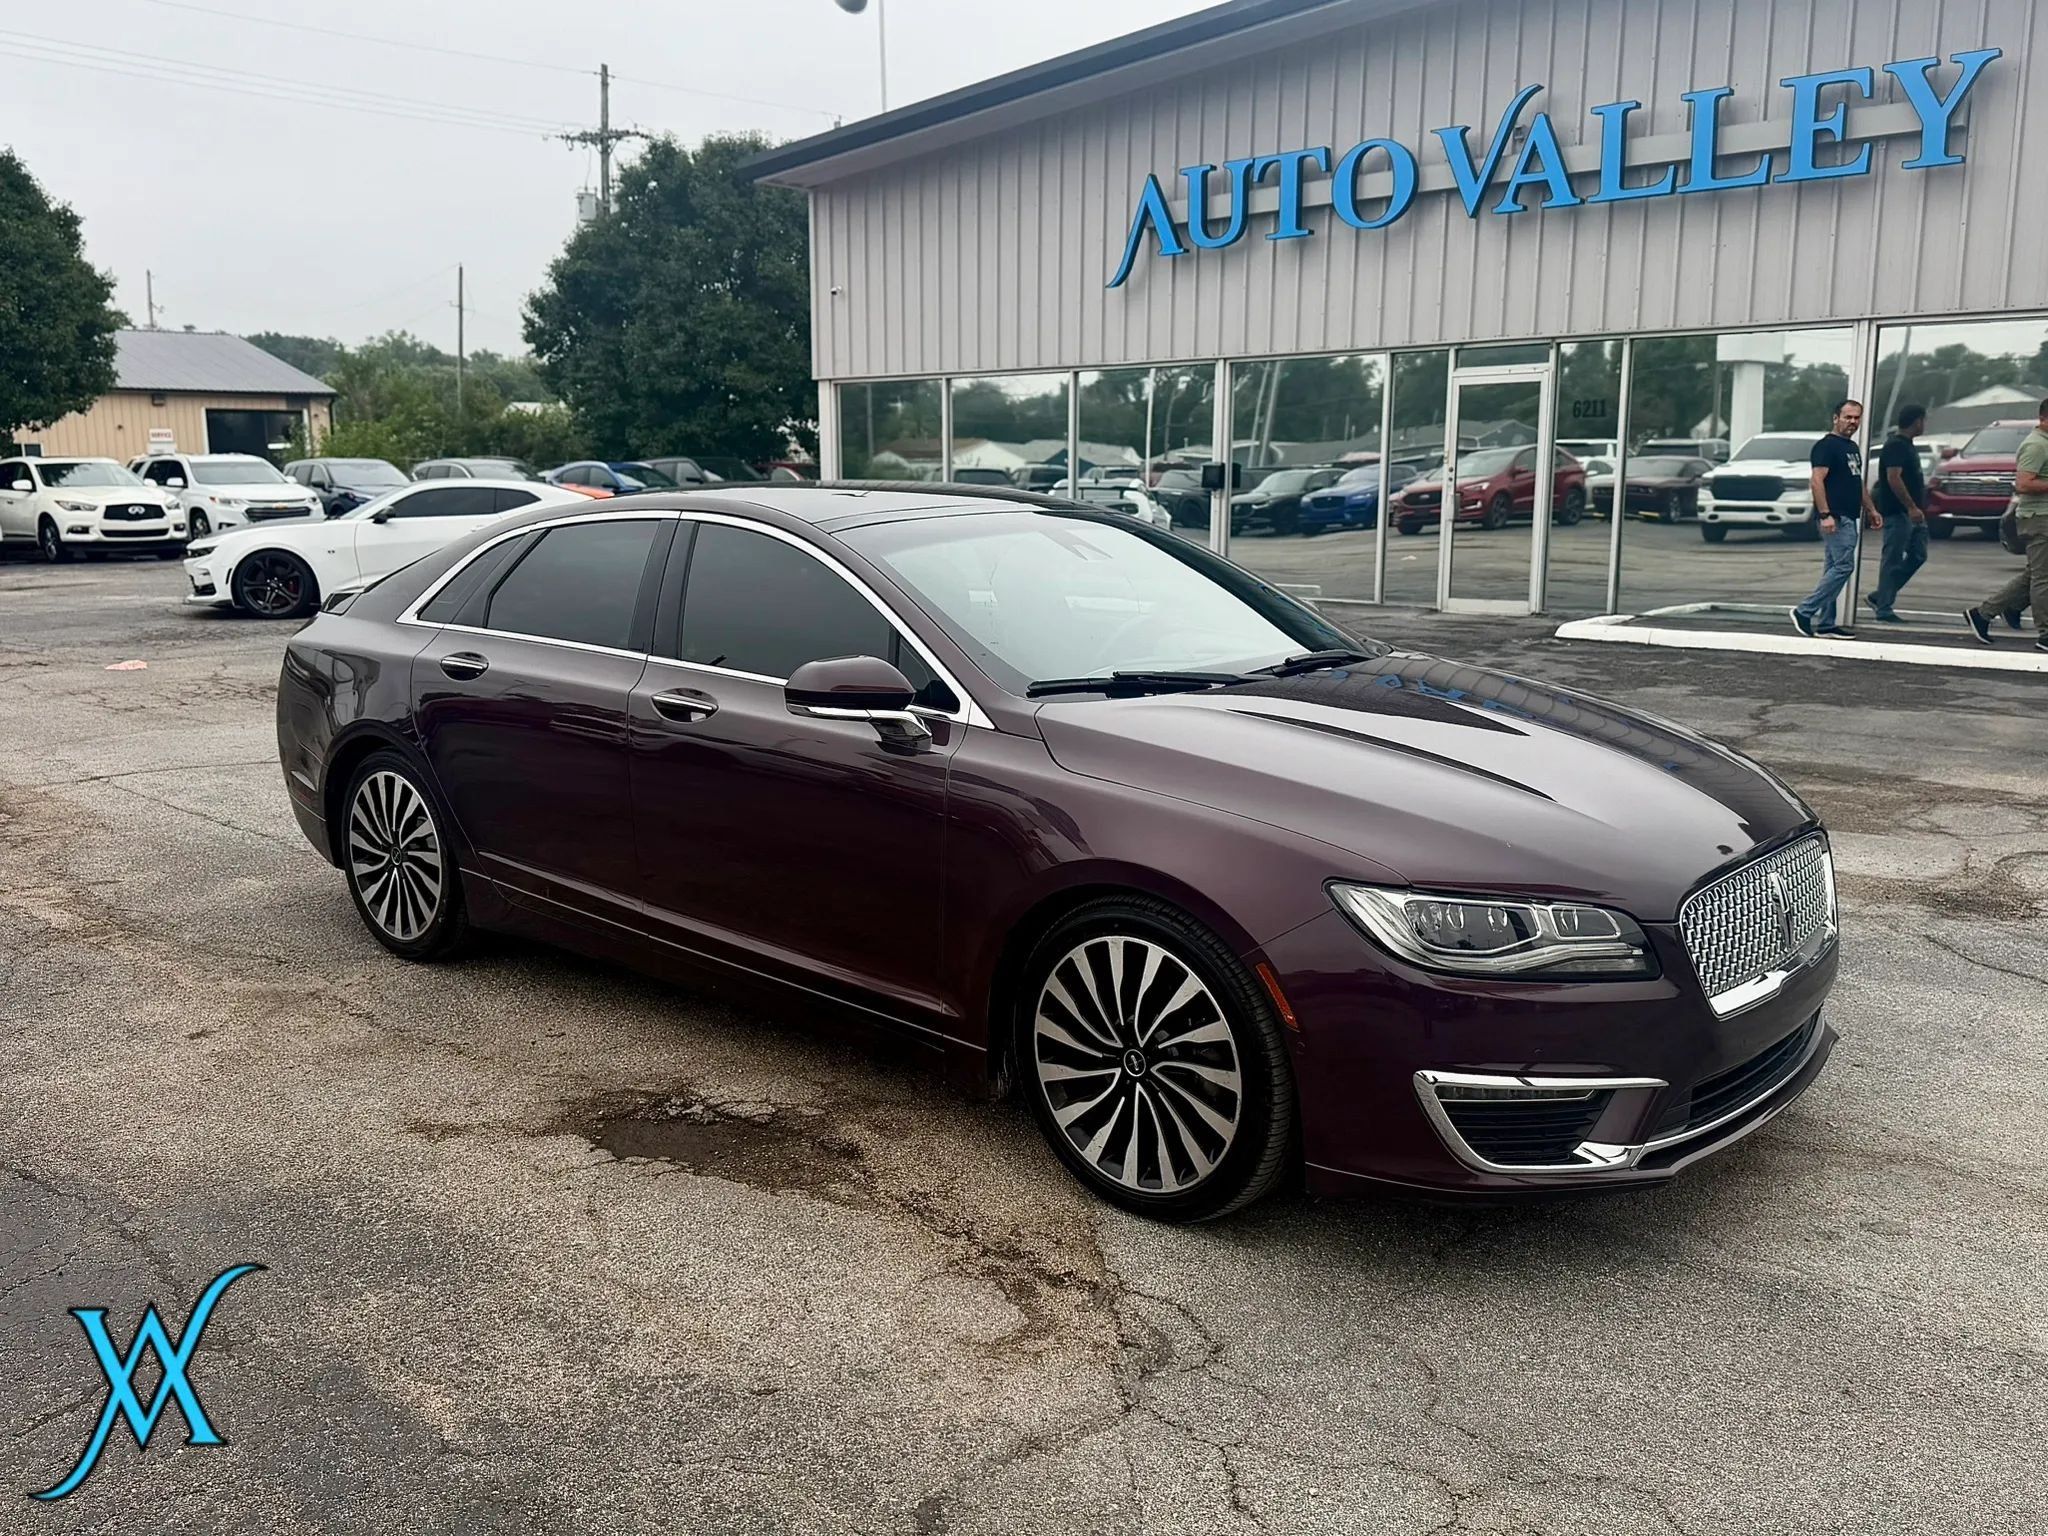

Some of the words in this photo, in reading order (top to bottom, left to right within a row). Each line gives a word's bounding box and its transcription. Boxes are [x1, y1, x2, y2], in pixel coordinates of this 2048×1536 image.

[1106, 138, 1419, 288] AUTO
[1431, 48, 2002, 218] VALLEY
[1573, 399, 1607, 418] 6211
